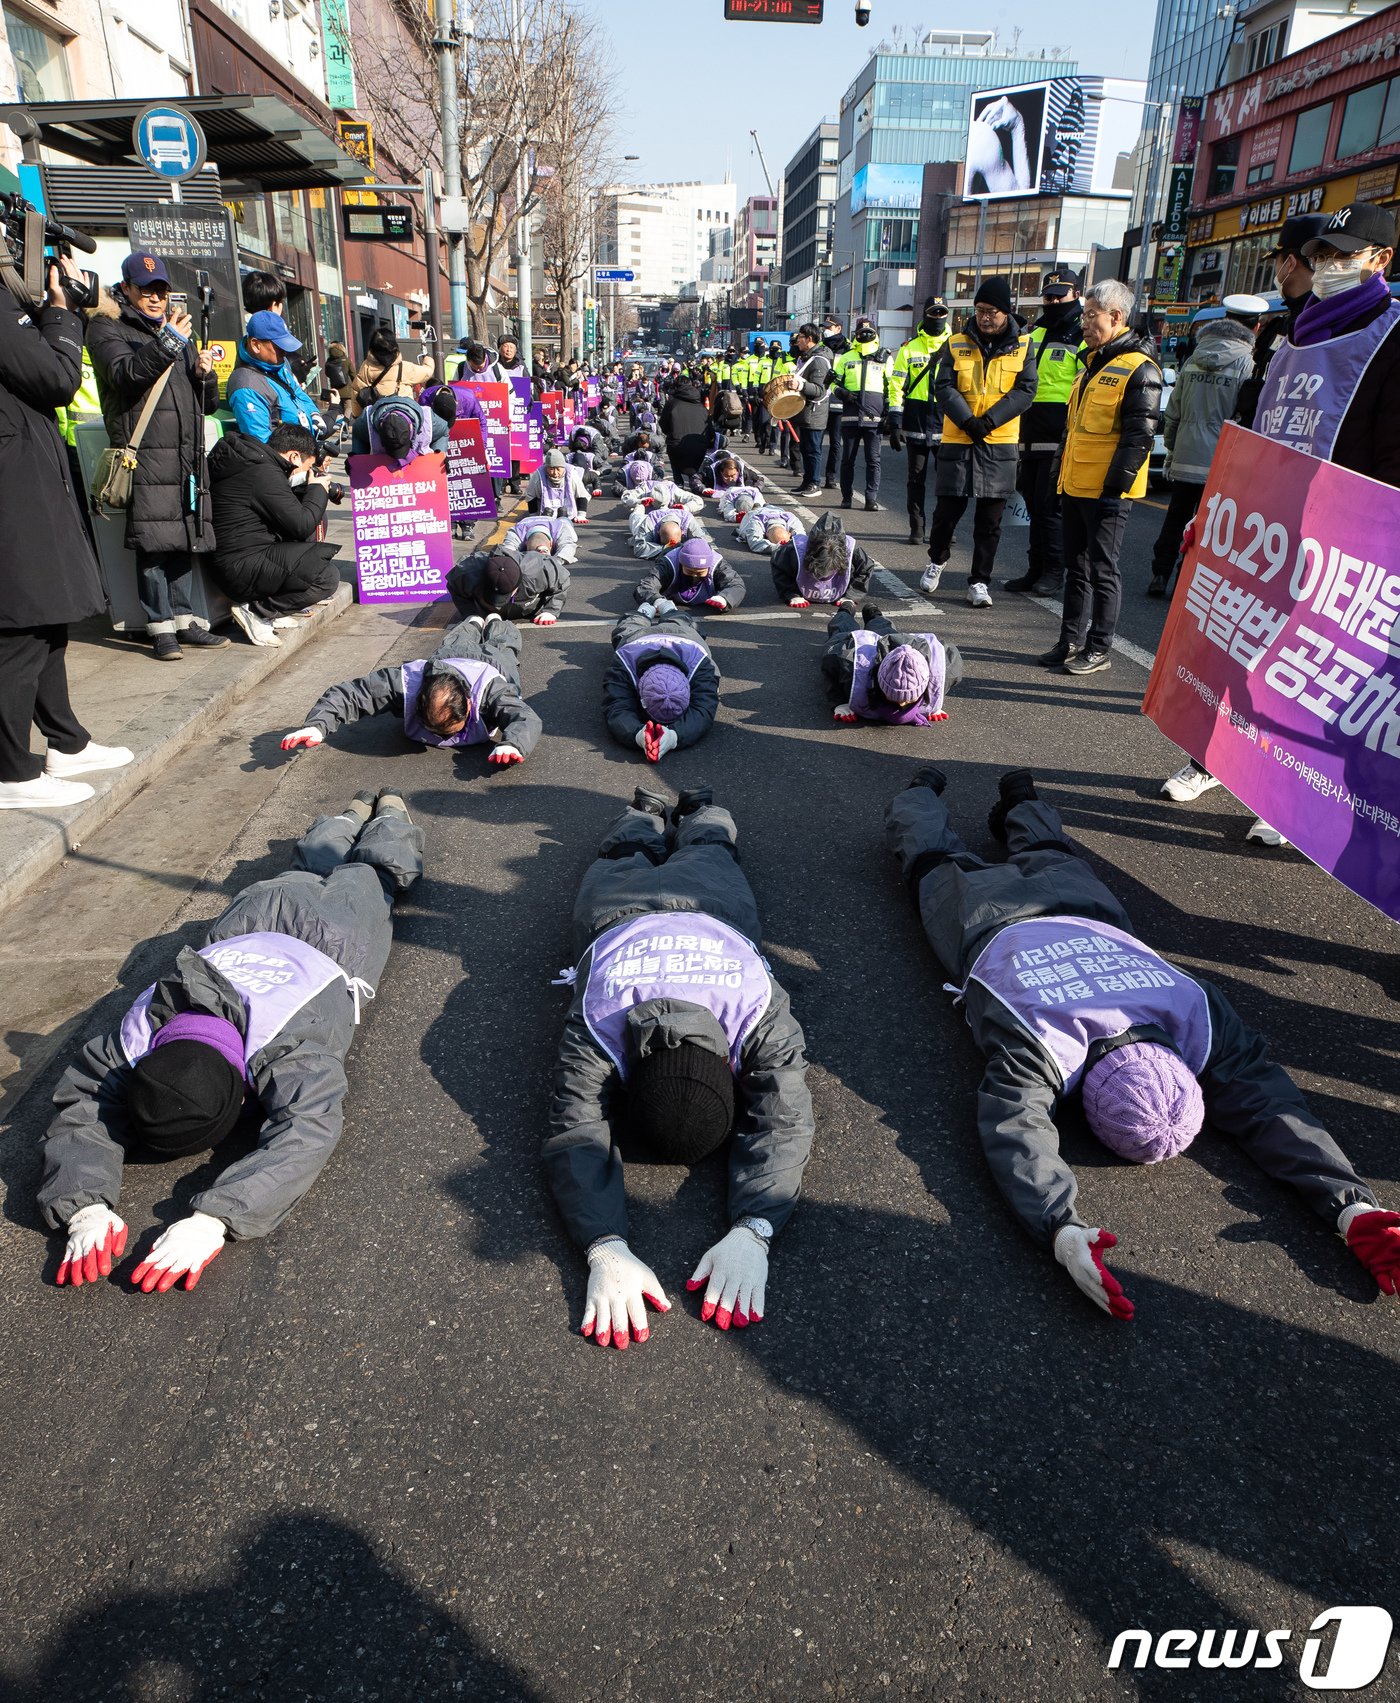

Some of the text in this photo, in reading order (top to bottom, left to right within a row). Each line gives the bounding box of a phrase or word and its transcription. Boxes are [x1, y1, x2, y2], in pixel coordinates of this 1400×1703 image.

[1340, 31, 1400, 69] 노래연습
[344, 132, 365, 140] emart
[1170, 171, 1187, 232] ALPEDO
[1249, 198, 1283, 226] 이바돔
[1286, 186, 1324, 218] 감자탕
[139, 238, 157, 246] Itaewon
[158, 239, 175, 247] Station
[176, 239, 185, 247] Exit
[212, 239, 225, 248] Hotel
[155, 247, 175, 256] 정류소
[177, 248, 184, 256] ID
[1189, 373, 1232, 387] POLICE
[1260, 405, 1324, 439] 이원 참사
[353, 486, 381, 500] 10.29
[381, 482, 414, 497] 이태원
[414, 480, 437, 494] 참사
[354, 494, 417, 512] 유가족입니다
[447, 497, 487, 512] 하십시오
[356, 513, 389, 529] 윤석열
[356, 520, 448, 541] 이태원 참사 특별법
[358, 540, 427, 561] 유가족들을
[1198, 490, 1289, 584] 10.29
[360, 554, 431, 577] 먼저 만나고
[361, 569, 442, 591] 결정하십시오
[1184, 560, 1291, 674] 특별법
[1175, 665, 1194, 685] 10.29
[1217, 699, 1259, 745] 유가족협의회
[1272, 745, 1295, 769] 10.29
[1294, 760, 1344, 804] 이태원참사
[613, 934, 725, 964] 제정하라!
[1011, 935, 1123, 970] 제정하라!
[605, 952, 743, 979] 진상규명 특별법
[1015, 953, 1157, 989] 진상규명 특별법
[1038, 969, 1176, 1006] 이태원 참사
